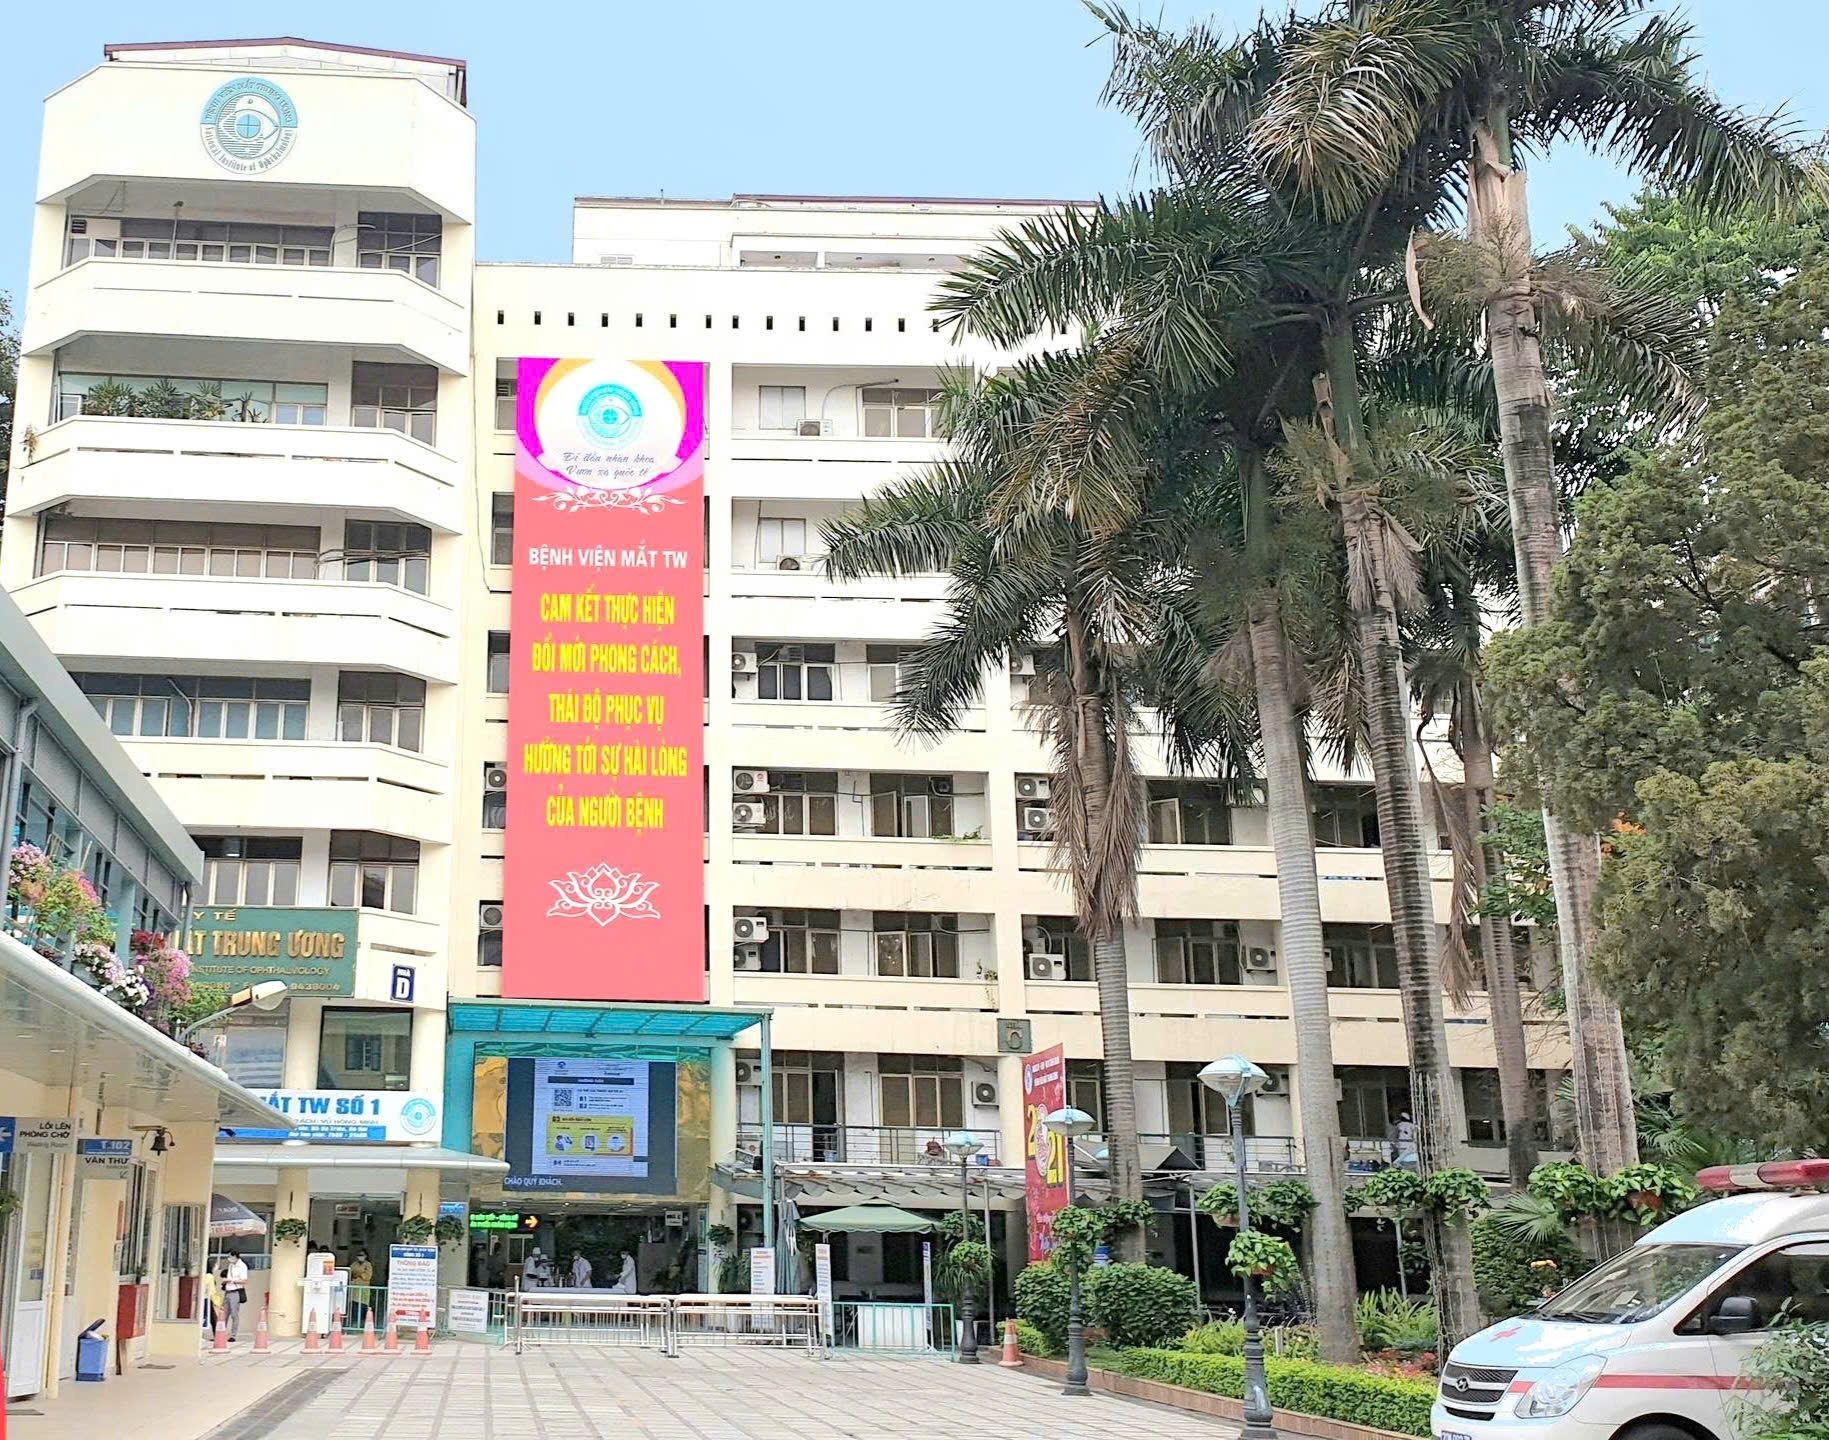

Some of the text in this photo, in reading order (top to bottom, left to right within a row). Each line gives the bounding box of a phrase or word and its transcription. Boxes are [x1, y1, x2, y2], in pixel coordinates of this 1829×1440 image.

[529, 539, 688, 571] BỆNH VIỆN MẮT TW
[540, 584, 675, 631] CAM KẾT THỰC HIỆN
[532, 631, 682, 678] ĐỔI MỚI PHONG CÁCH,
[548, 688, 665, 732] THÁI ĐỘ PHỤC VỤ
[523, 736, 572, 775] HƯỚNG
[576, 736, 597, 775] TỚI
[601, 743, 622, 782] SỰ
[651, 739, 688, 777] LÒNG
[546, 783, 665, 836] CỦA NGƯỜI BỆNH
[193, 909, 237, 921] Y TẾ
[211, 930, 281, 958] TRUNG
[287, 929, 346, 960] ƯƠNG
[395, 976, 411, 1001] D
[298, 1096, 331, 1115] TW
[335, 1094, 366, 1116] SỐ
[370, 1098, 380, 1116] 1
[20, 1130, 70, 1139] PHÒNG CHỜ
[40, 1120, 71, 1130] LỐI LÊN
[101, 1141, 131, 1150] T.102
[108, 1157, 129, 1165] THƯ
[504, 1177, 523, 1186] CHÀO
